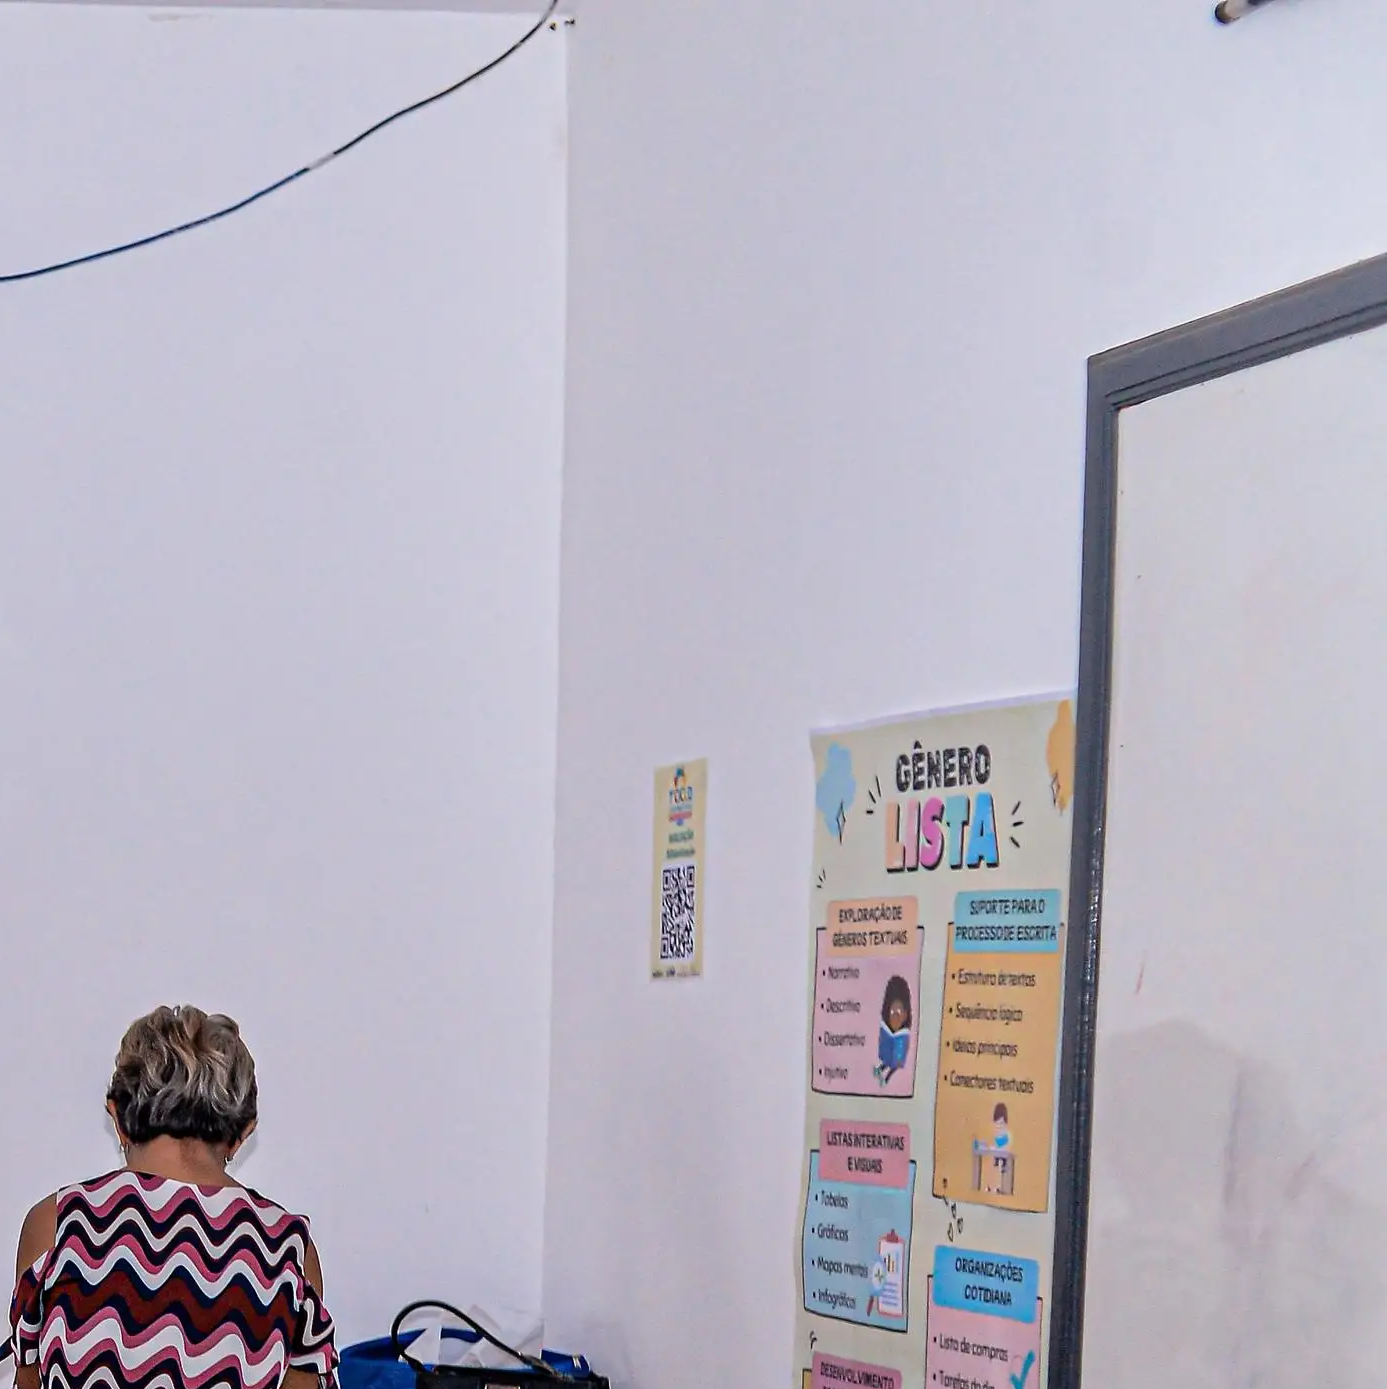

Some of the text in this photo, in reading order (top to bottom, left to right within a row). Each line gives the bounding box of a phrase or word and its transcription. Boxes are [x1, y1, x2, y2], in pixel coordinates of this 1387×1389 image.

[895, 740, 991, 792] GÊNERO
[885, 791, 1000, 874] LISTA
[838, 903, 903, 924] EXPLORAÇÃO DE
[969, 898, 1046, 916] SUPORTE PARA O
[832, 930, 908, 947] GÊNEROS TEXTUAIS
[955, 925, 1057, 941] PROCESSO DE ESCRITA
[827, 1131, 905, 1151] LISTAS INTERATIVAS
[848, 1158, 883, 1173] E VISUAIS
[817, 1223, 849, 1242] Gráficos
[817, 1257, 842, 1277] Mapas
[955, 1257, 1024, 1284] ORGANIZAÇÕES
[964, 1284, 1012, 1306] COTIDIANA
[939, 1333, 1009, 1363] Lista de compras
